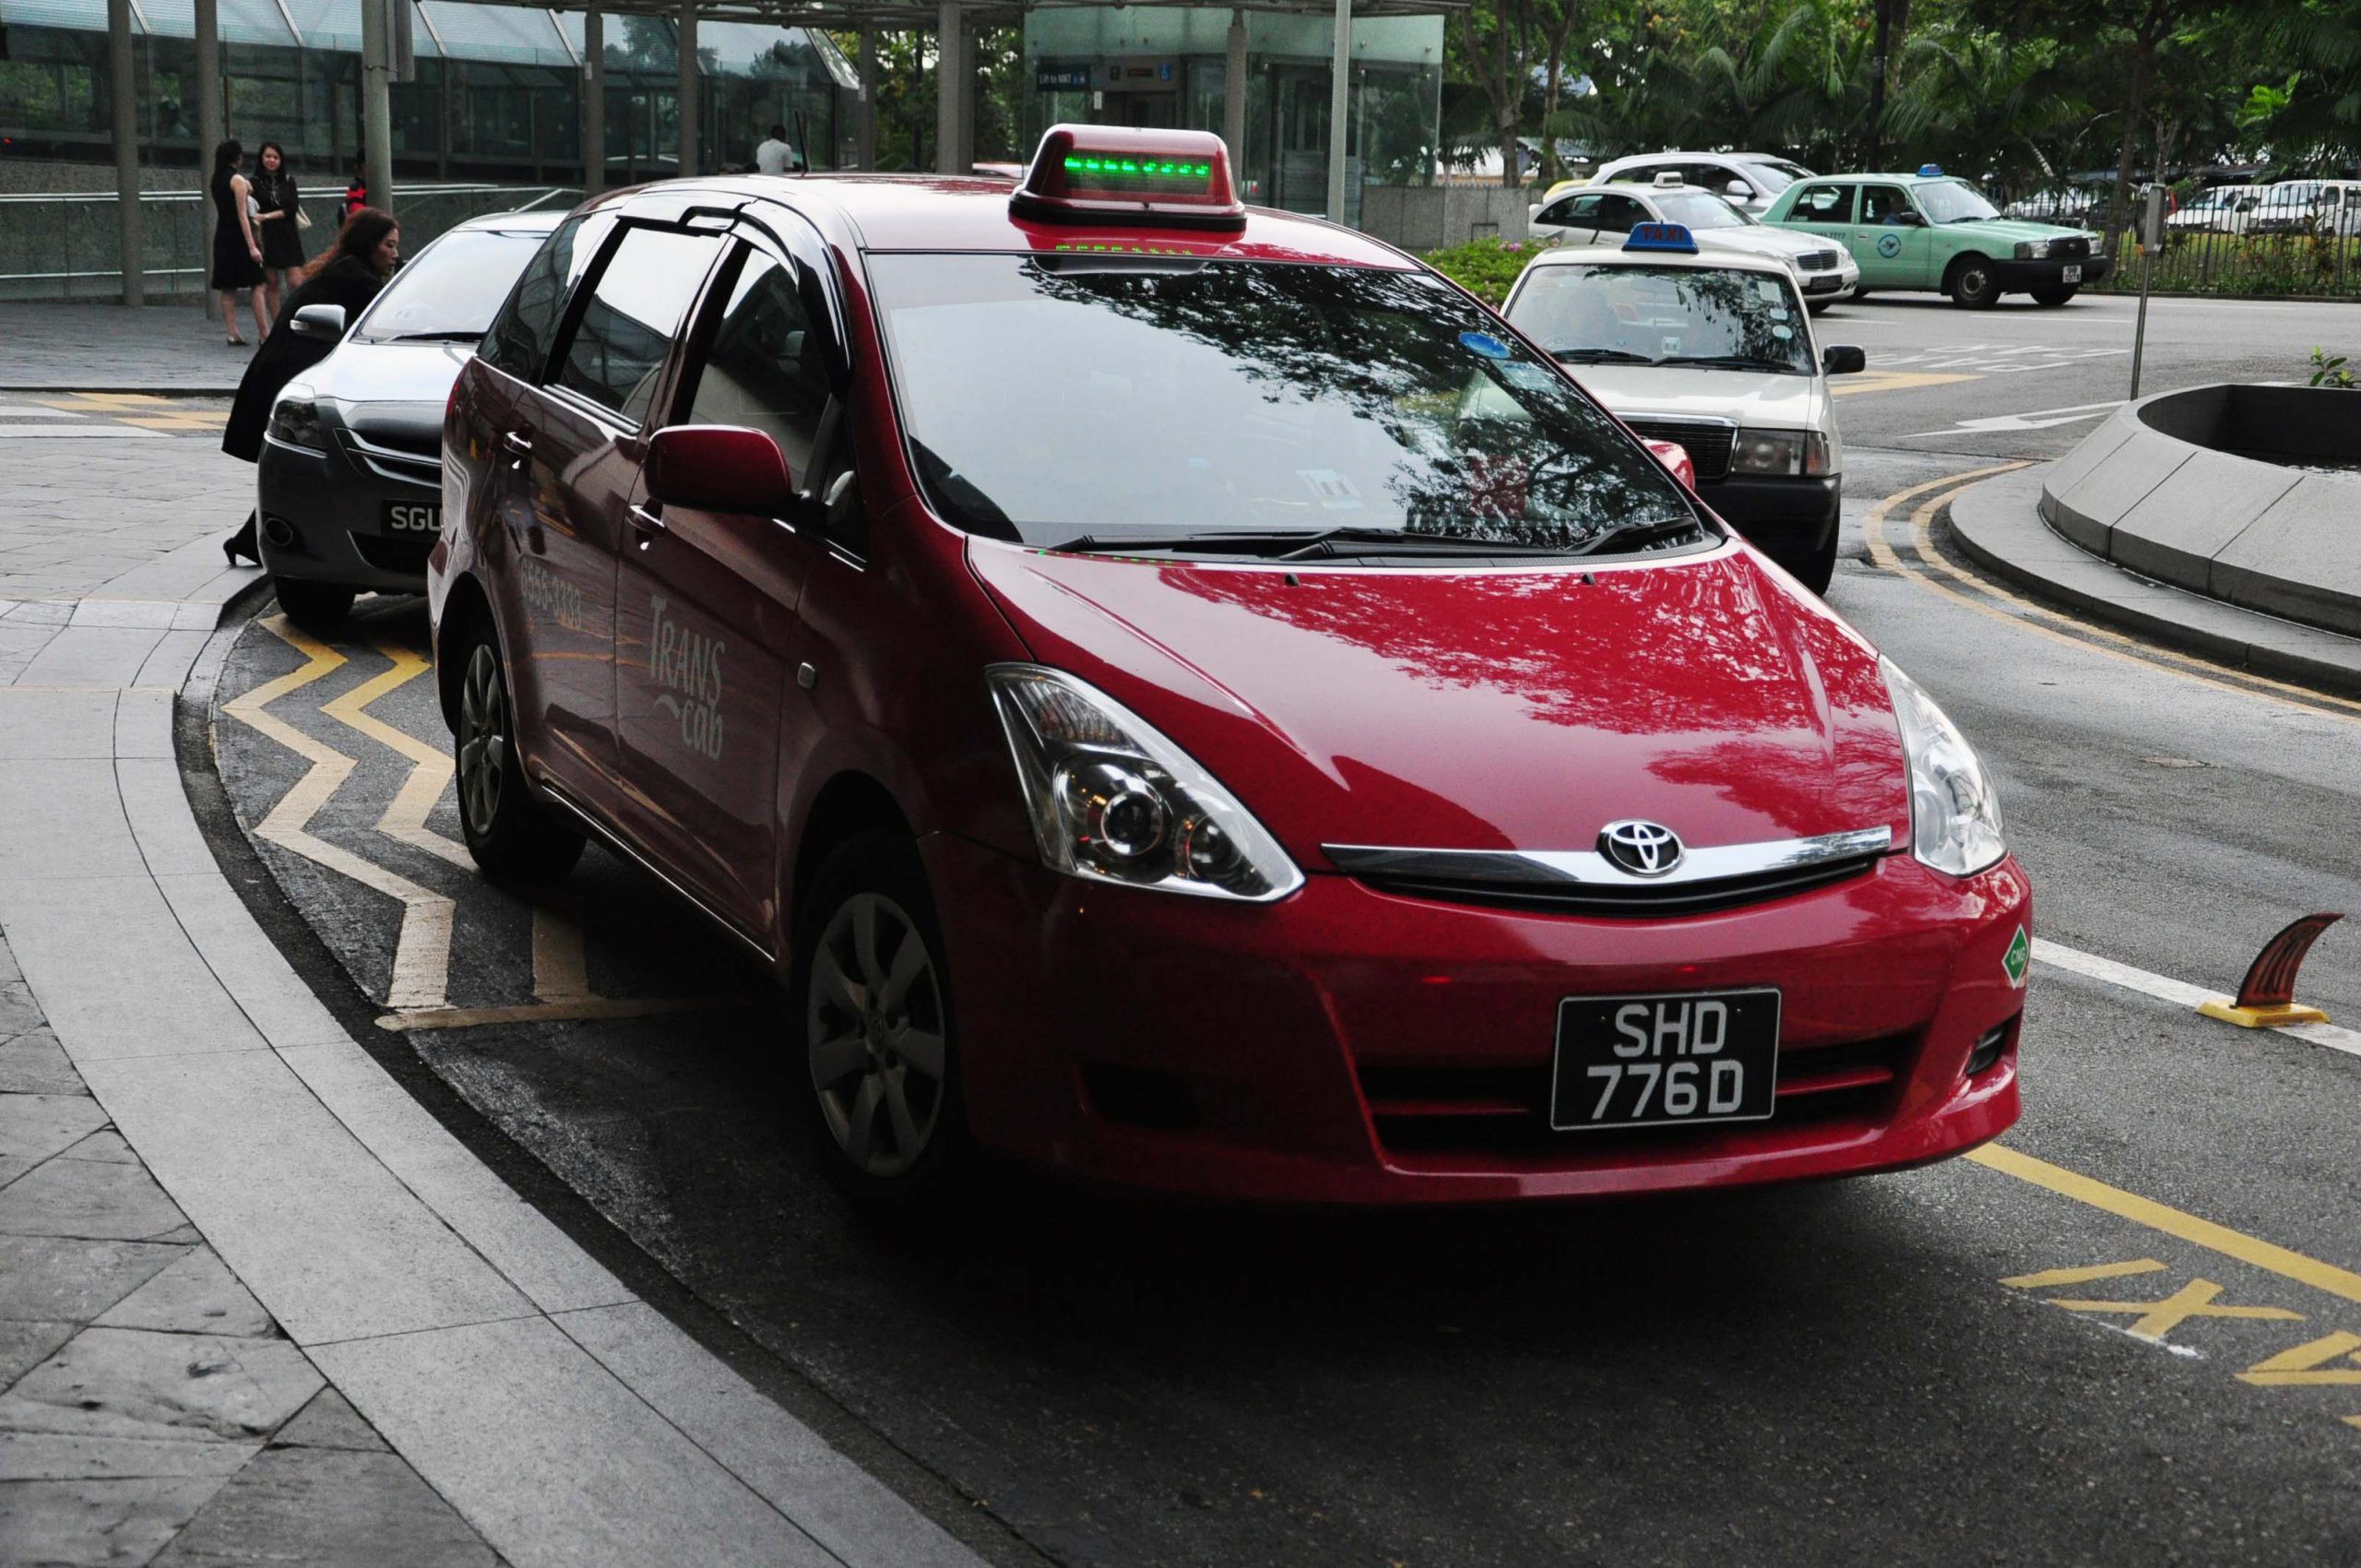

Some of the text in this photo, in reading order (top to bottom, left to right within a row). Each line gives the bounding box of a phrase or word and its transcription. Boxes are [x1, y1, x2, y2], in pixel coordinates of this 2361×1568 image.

[1643, 226, 1684, 242] TAXI
[682, 698, 724, 762] cab
[2011, 945, 2026, 966] CNG
[1613, 1001, 1727, 1058] SHD
[1586, 1060, 1744, 1120] 776D
